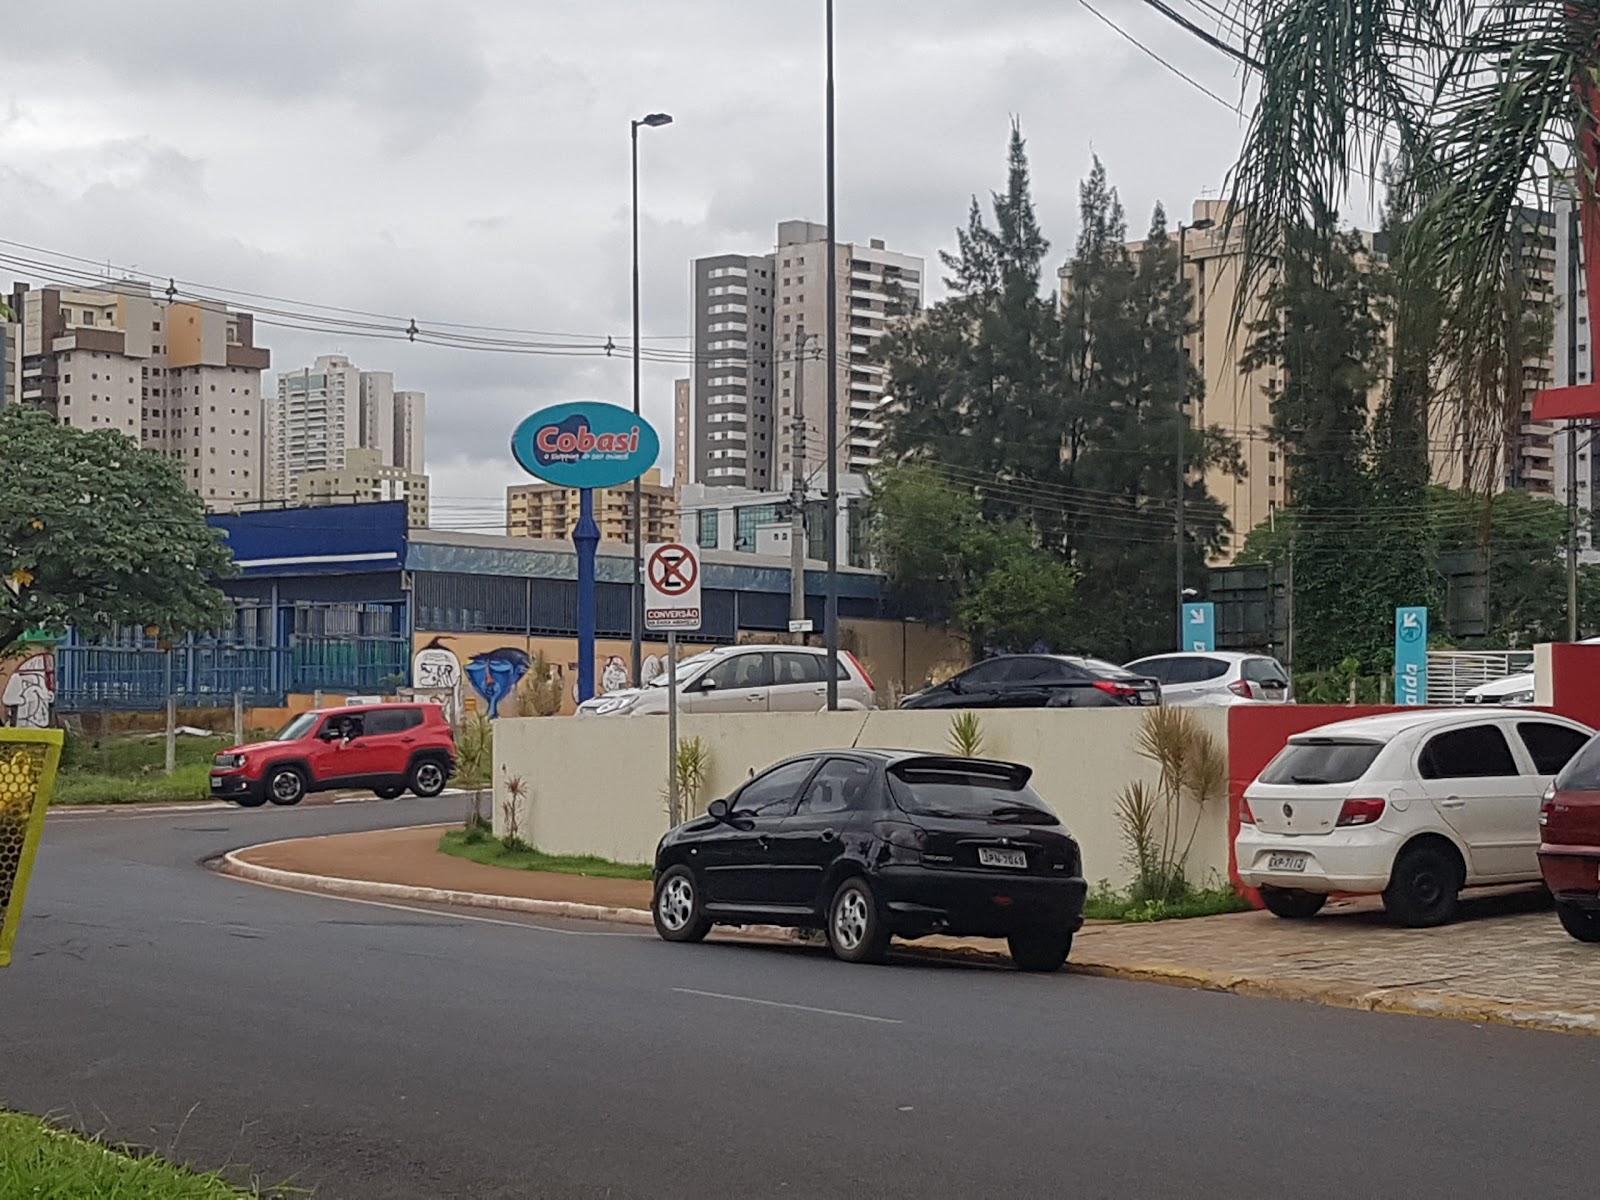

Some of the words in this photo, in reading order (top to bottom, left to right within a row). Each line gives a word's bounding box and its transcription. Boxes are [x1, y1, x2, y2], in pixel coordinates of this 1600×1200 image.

[537, 425, 640, 452] Cobasi
[647, 609, 698, 619] CONVERSÃO
[1402, 664, 1417, 706] aída
